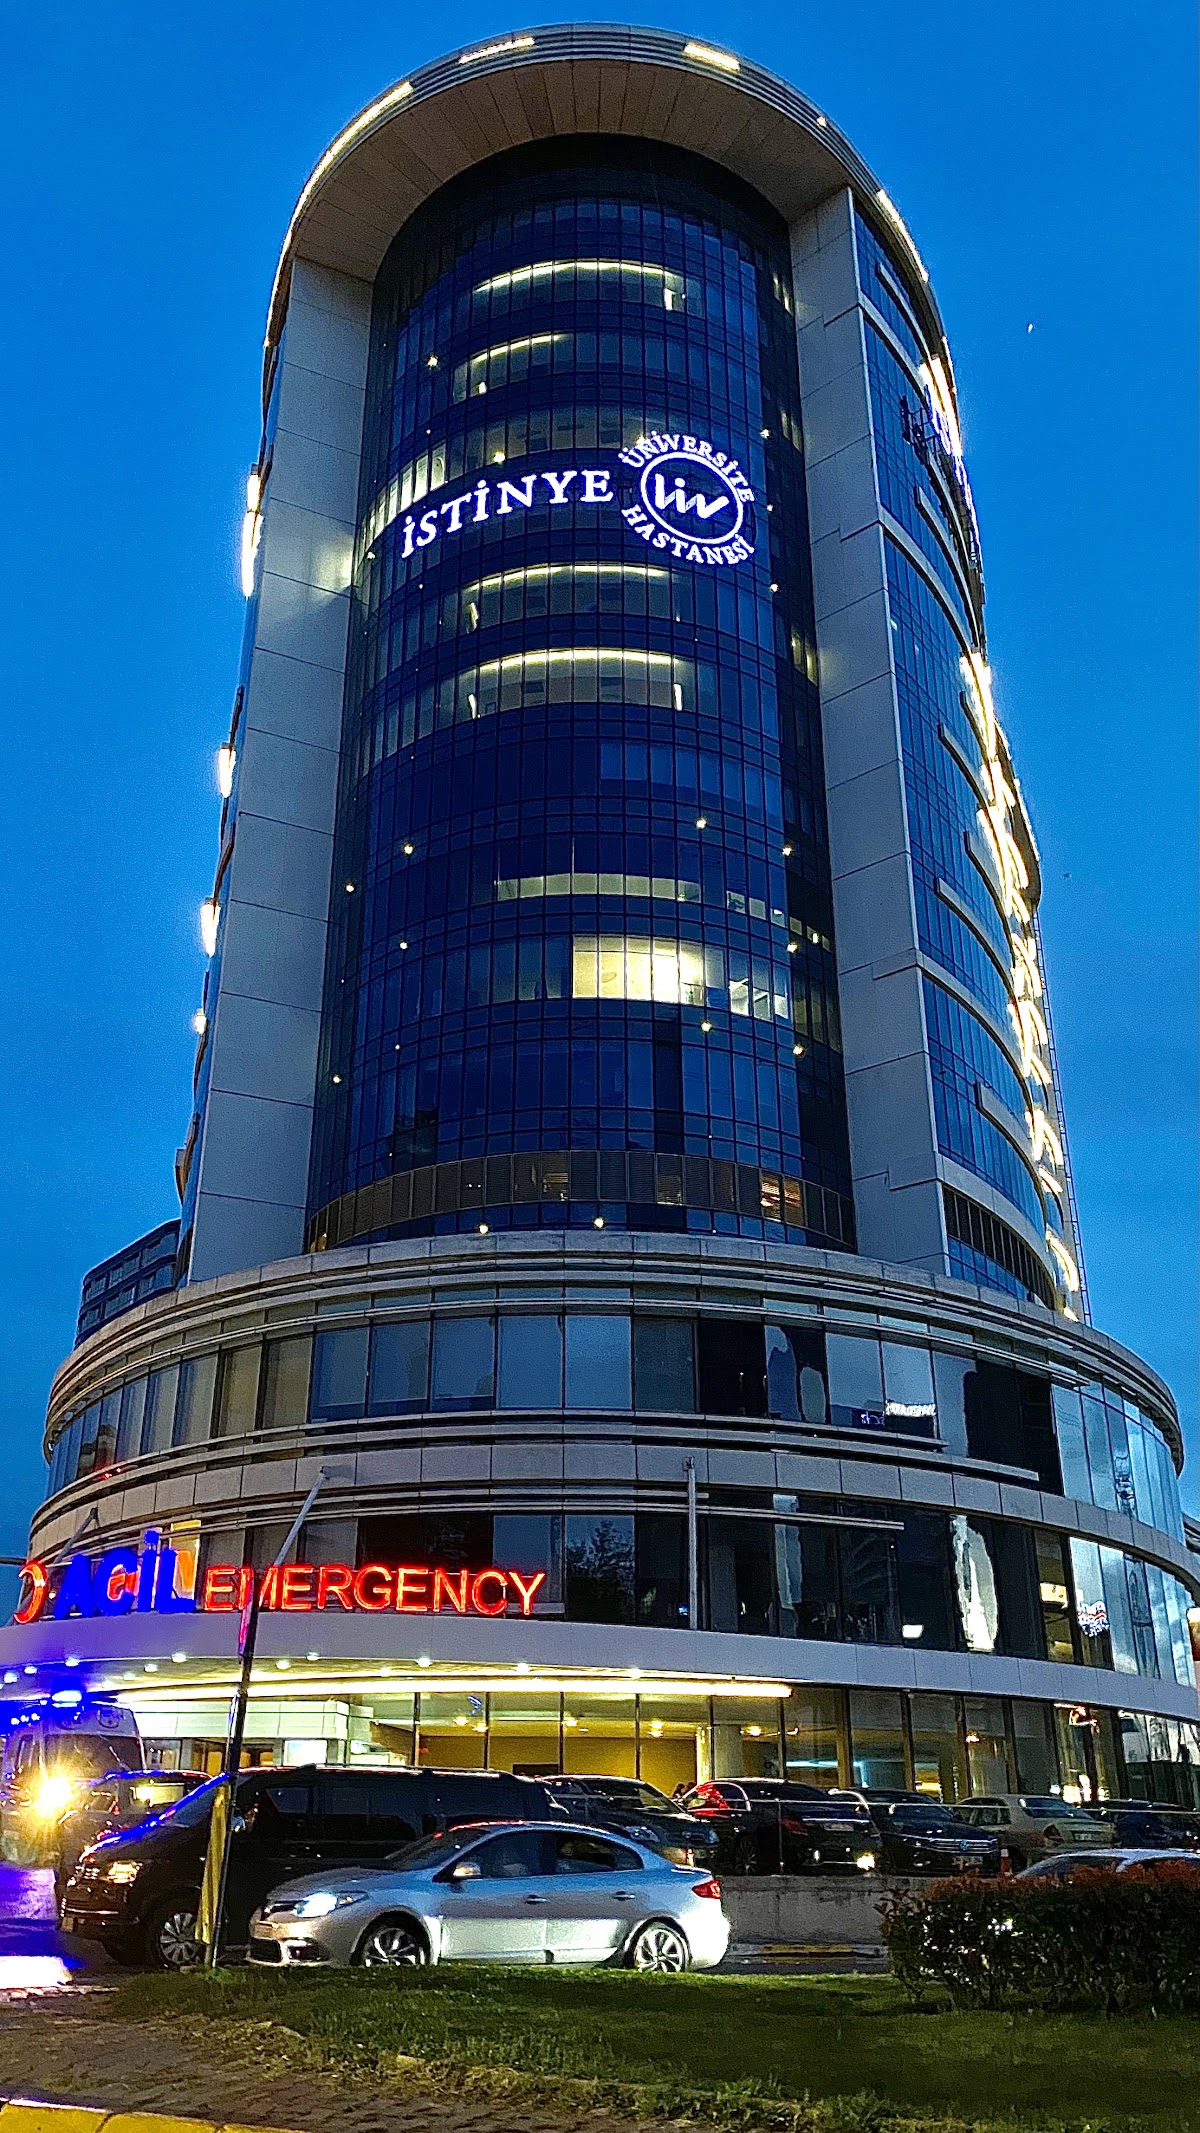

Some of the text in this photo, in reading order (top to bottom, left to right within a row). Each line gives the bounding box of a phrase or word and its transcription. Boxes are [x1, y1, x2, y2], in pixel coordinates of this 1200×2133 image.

[402, 469, 614, 559] İSTİNYE
[621, 504, 755, 565] HASTANESİ
[204, 1563, 546, 1617] EMERGENCY
